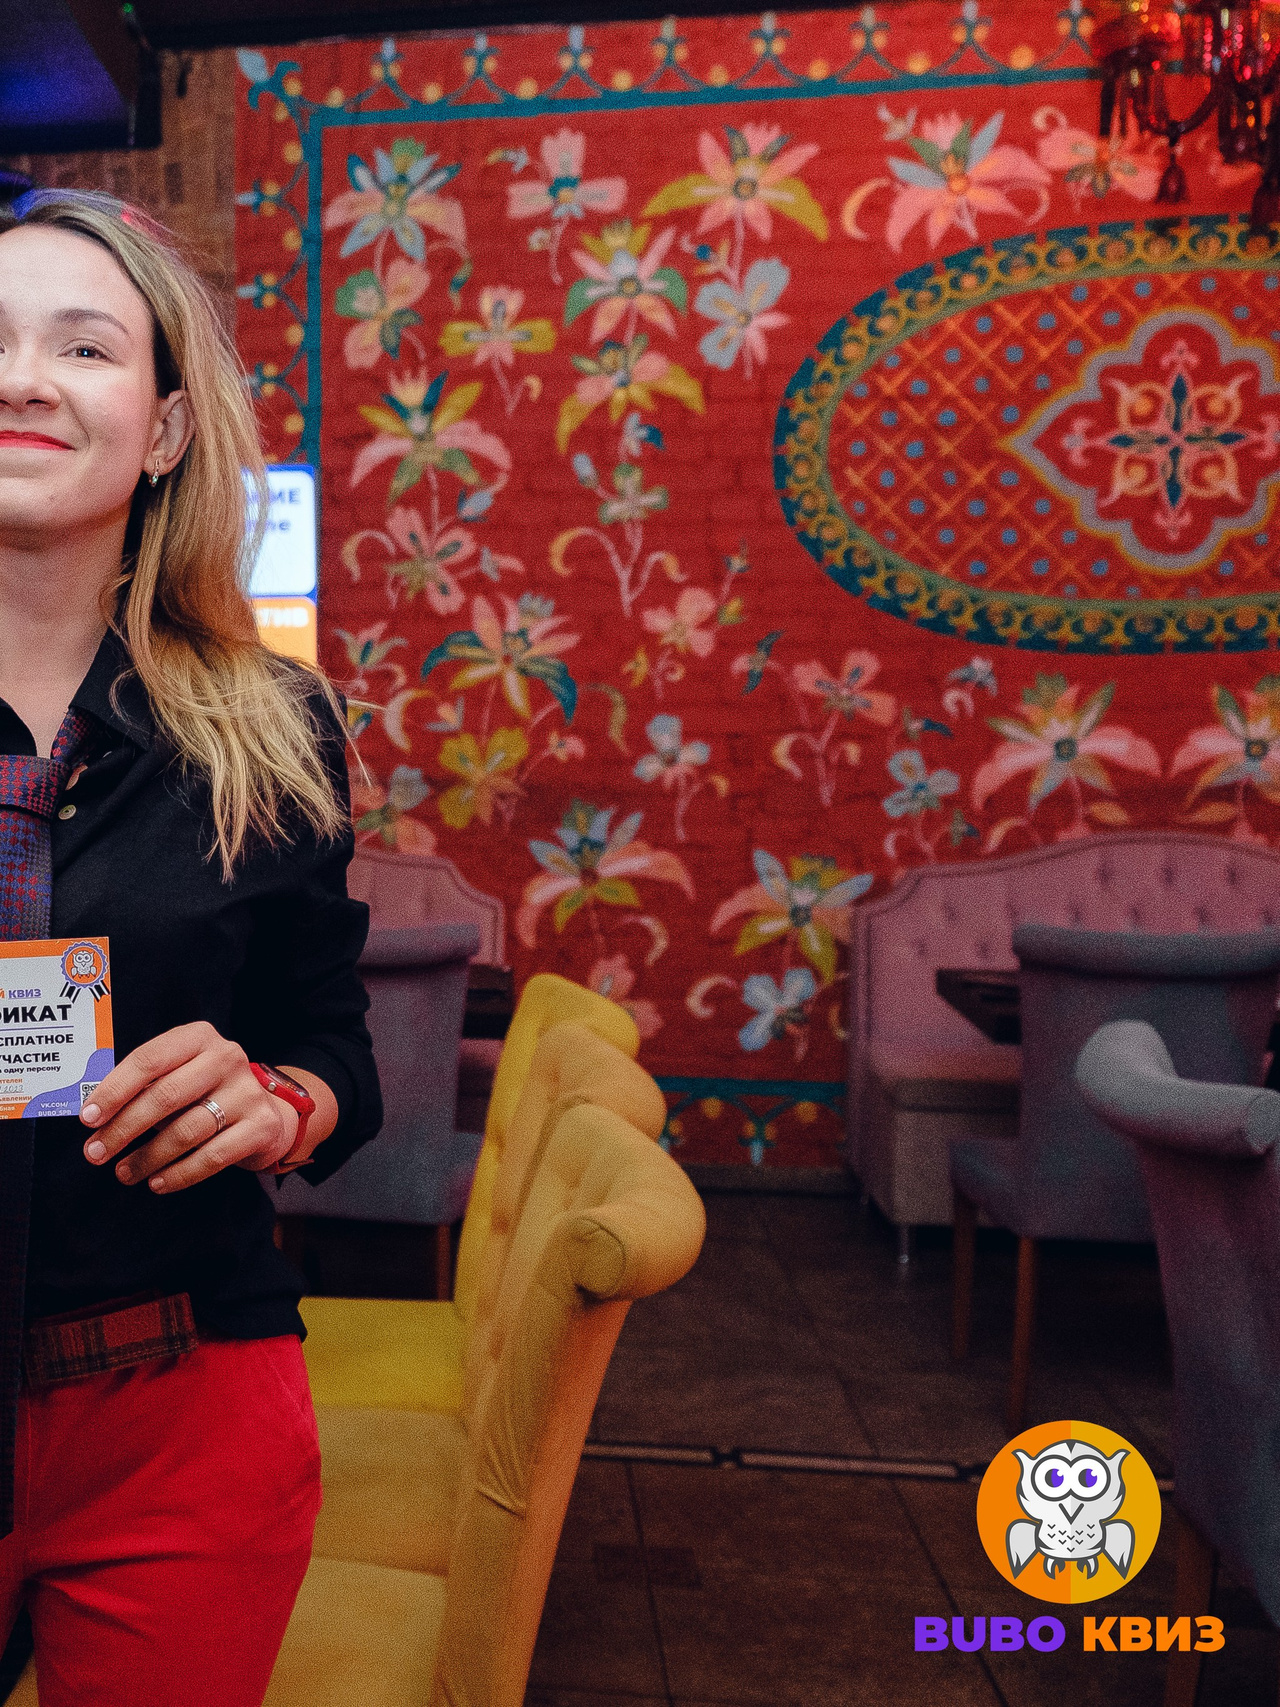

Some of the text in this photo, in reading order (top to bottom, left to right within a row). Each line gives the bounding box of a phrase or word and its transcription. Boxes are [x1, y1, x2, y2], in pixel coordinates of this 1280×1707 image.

[8, 988, 42, 1000] КВИЗ
[3, 1066, 24, 1075] одну
[26, 1065, 61, 1074] персону
[40, 1101, 69, 1109] VK.COM/
